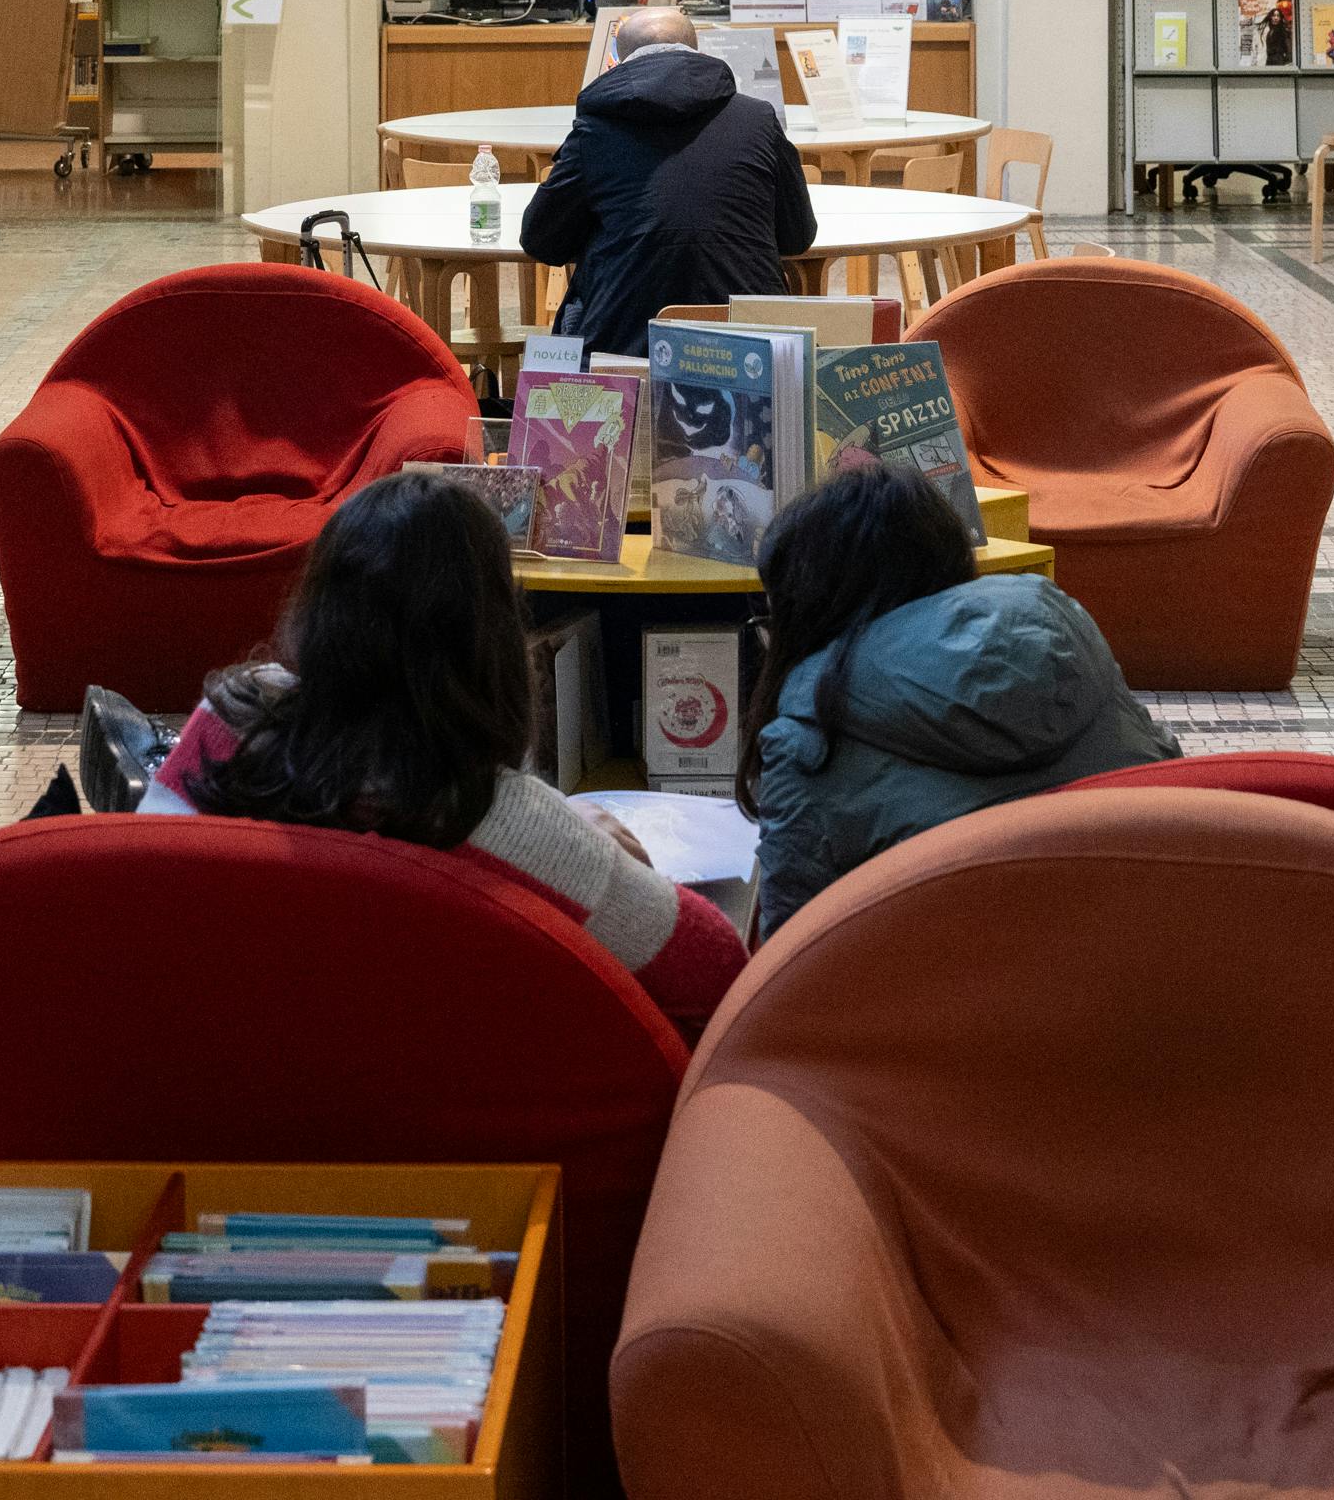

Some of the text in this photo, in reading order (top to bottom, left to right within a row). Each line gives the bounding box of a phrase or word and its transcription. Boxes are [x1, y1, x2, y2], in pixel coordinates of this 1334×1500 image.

[533, 349, 579, 361] novità
[678, 359, 738, 378] PALLONCINO
[860, 360, 937, 398] CONFINI
[877, 396, 951, 437] SPAZIO
